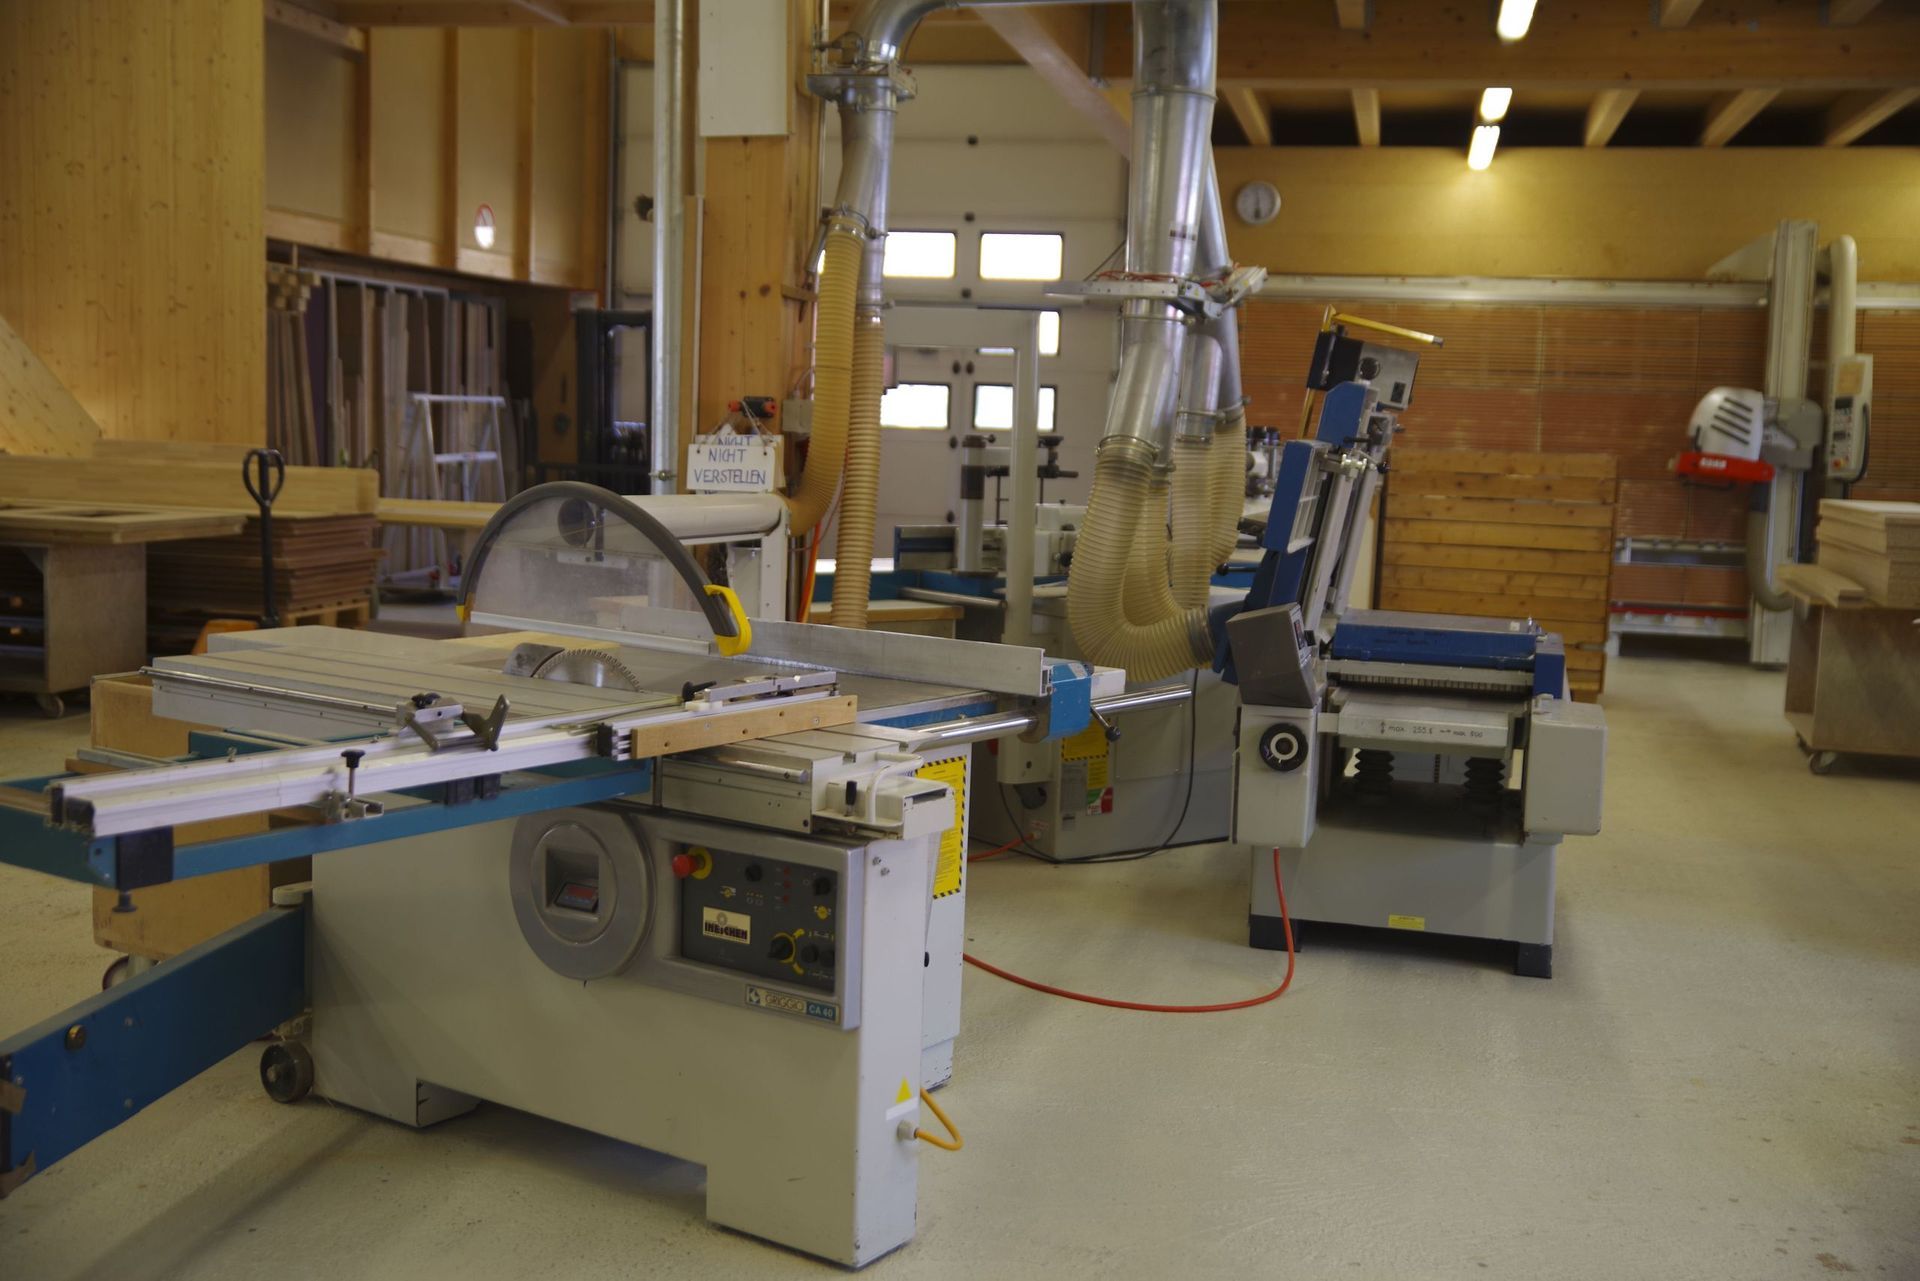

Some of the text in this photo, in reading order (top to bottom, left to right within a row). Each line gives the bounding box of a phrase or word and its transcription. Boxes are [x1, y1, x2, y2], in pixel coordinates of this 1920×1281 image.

[709, 448, 746, 462] NICHT
[694, 468, 766, 484] VERSTELLEN
[808, 1004, 821, 1015] CA
